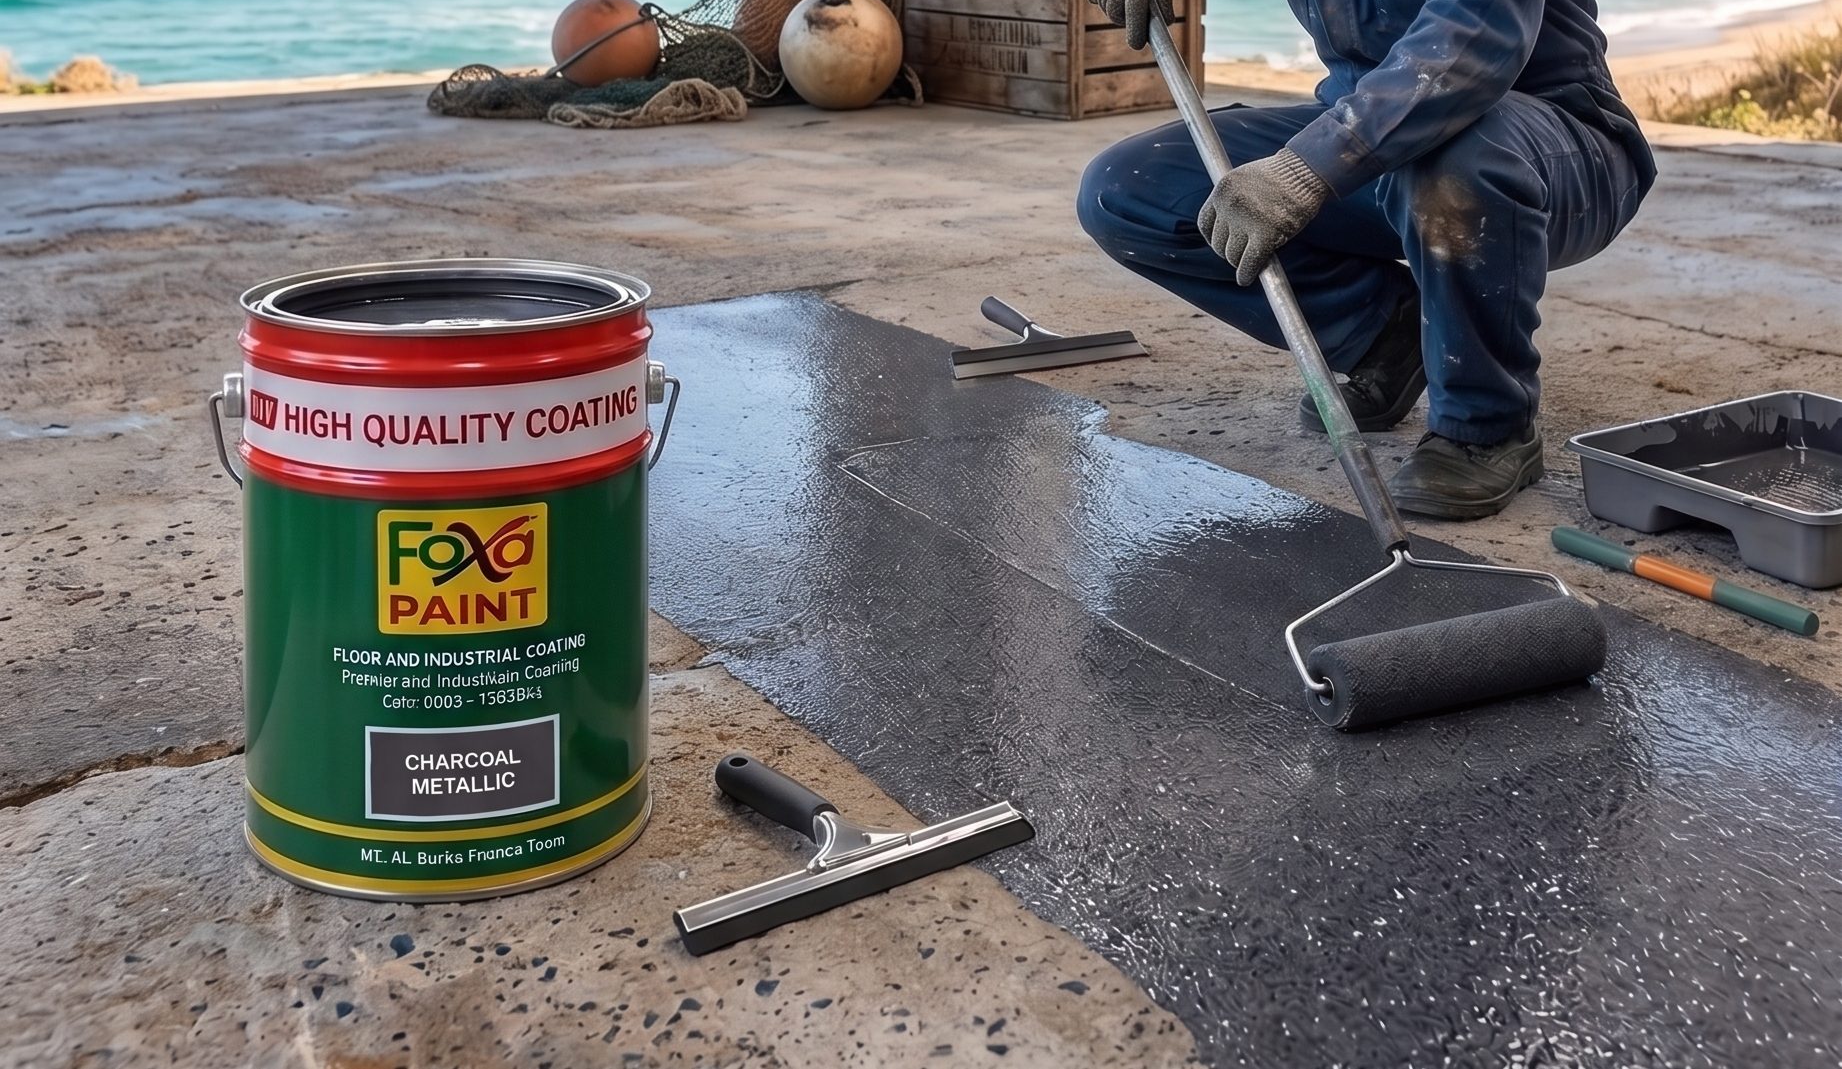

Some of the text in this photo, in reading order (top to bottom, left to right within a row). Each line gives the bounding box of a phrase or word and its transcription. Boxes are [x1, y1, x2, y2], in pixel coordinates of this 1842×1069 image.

[285, 385, 638, 448] HIGH QUALITY COATING
[389, 587, 537, 625] PAINT
[333, 633, 586, 667] FLOOR AND INDUSTRIAL COATING
[424, 694, 463, 709] 0003
[405, 749, 521, 771] CHARCOAL
[412, 771, 515, 795] METALLIC
[391, 851, 412, 865] AL
[527, 835, 565, 853] Toom
